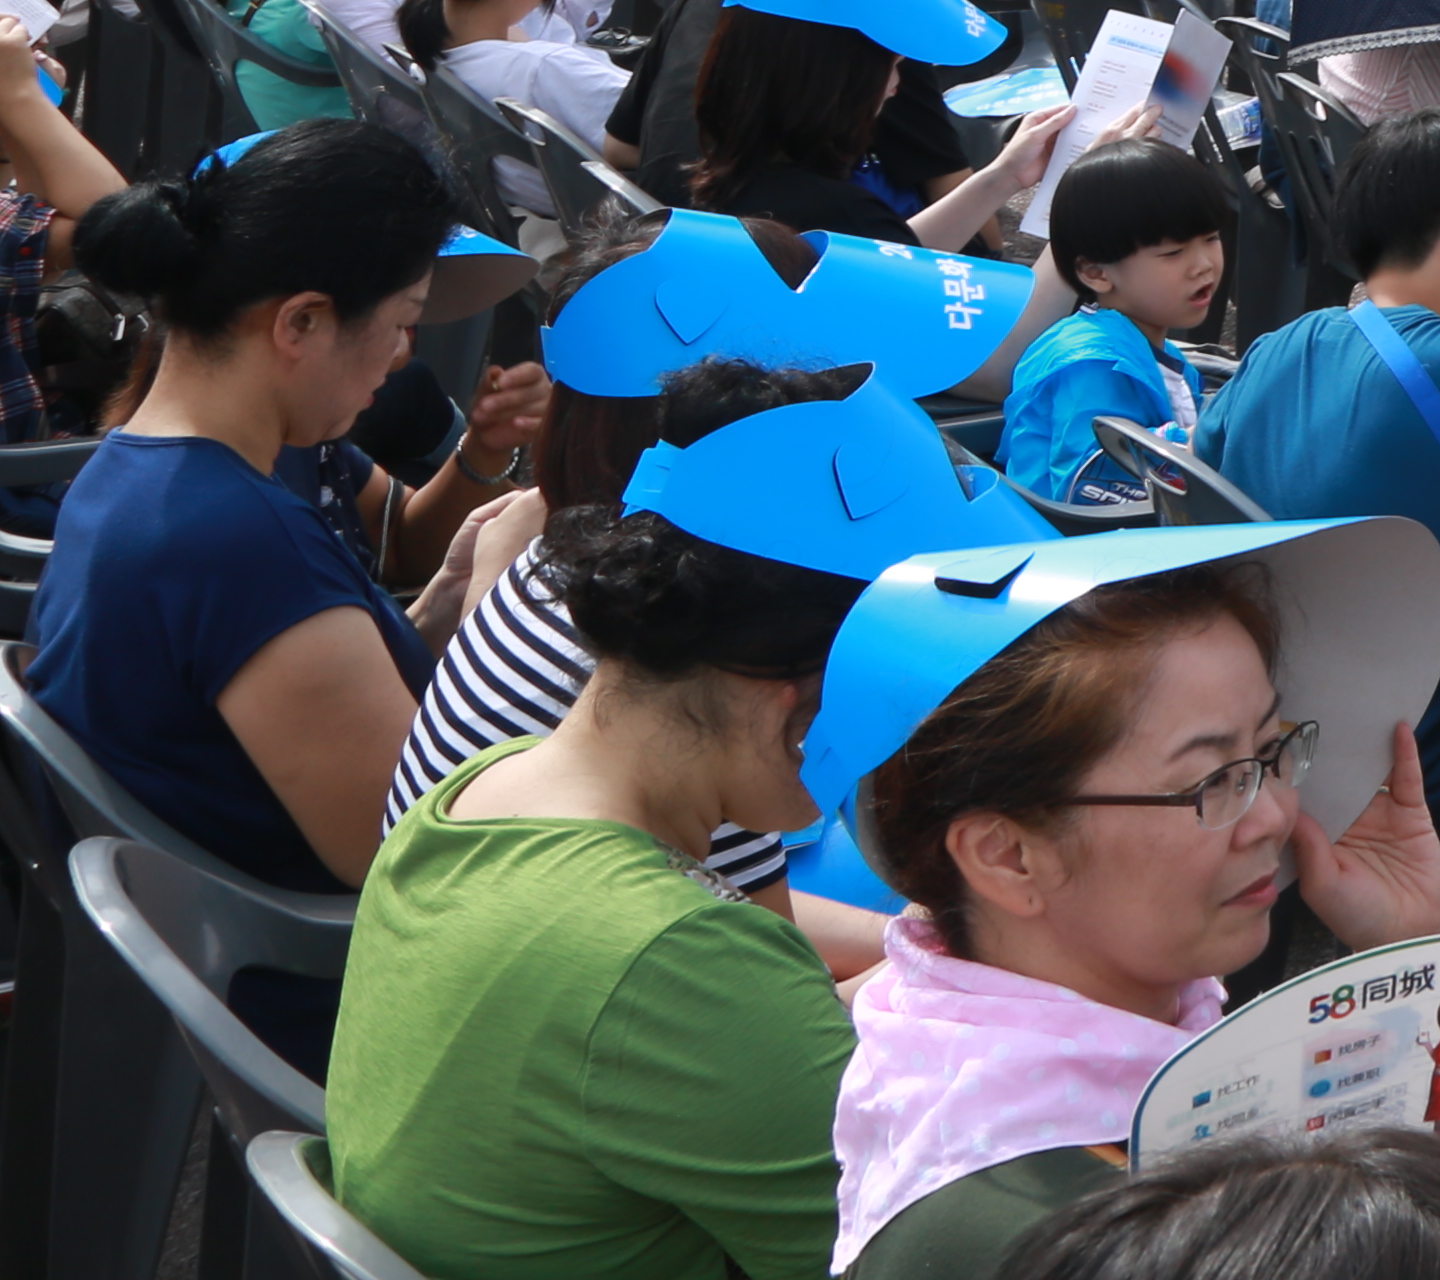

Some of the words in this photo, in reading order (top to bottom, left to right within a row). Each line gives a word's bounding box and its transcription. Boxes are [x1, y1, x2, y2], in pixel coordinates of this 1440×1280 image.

[1308, 964, 1437, 1024] 58同城
[1338, 1034, 1382, 1056] 找房子
[1217, 1074, 1261, 1100] 找工作
